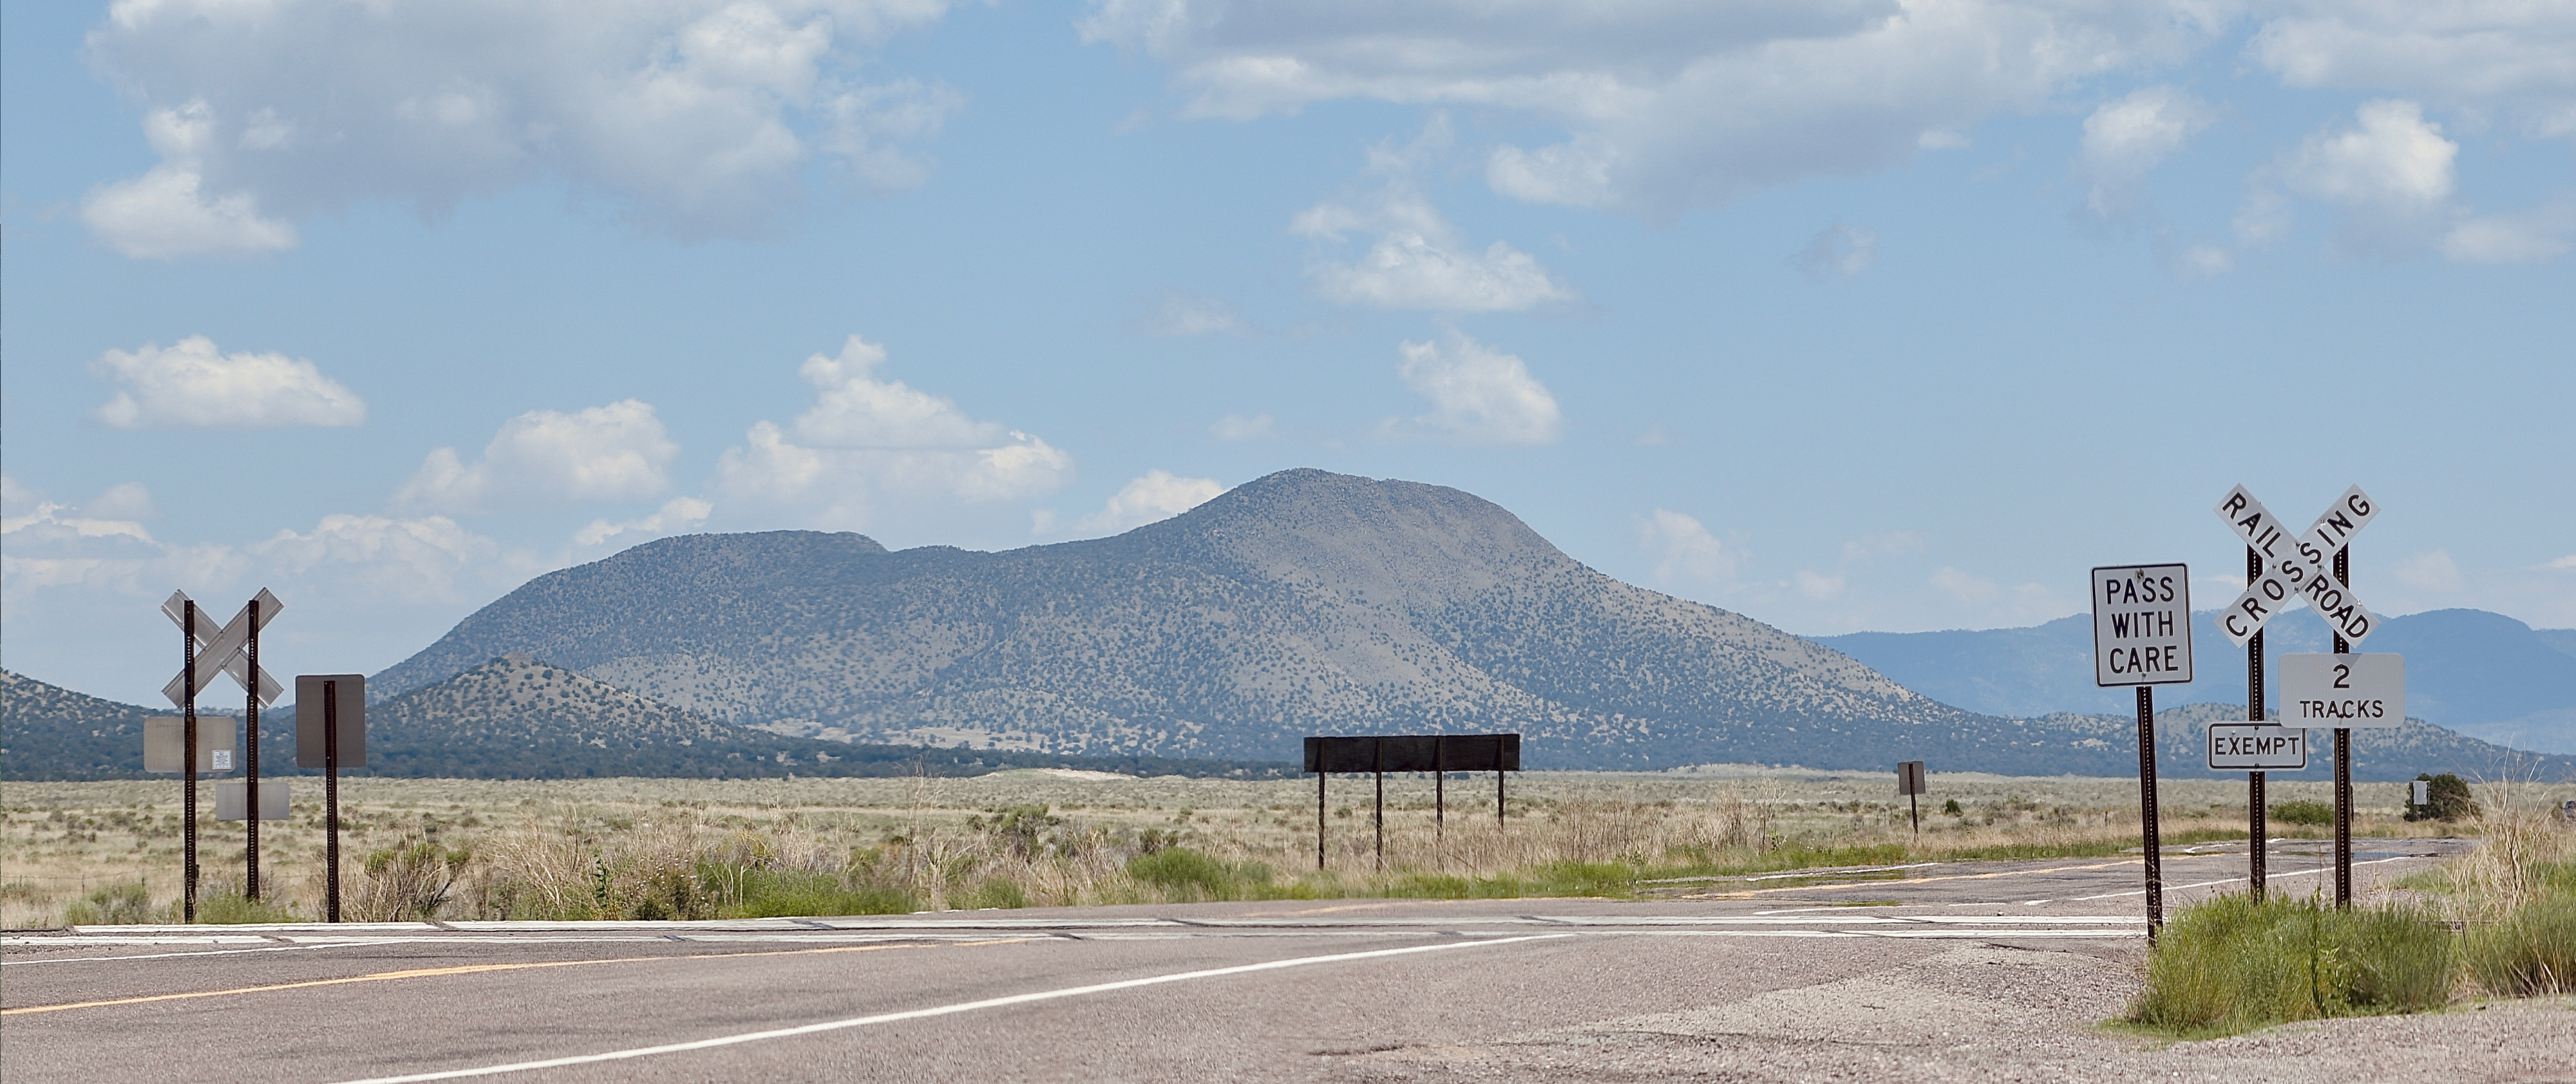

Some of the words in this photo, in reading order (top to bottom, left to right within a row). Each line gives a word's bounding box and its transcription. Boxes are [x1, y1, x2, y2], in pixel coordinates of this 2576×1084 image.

[2222, 492, 2281, 558] RAIL
[2305, 574, 2370, 639] ROAD
[2226, 494, 2371, 637] CROSSING
[2106, 576, 2174, 604] PASS
[2112, 611, 2174, 639] WITH
[2109, 646, 2179, 673] CARE
[2333, 665, 2351, 689] 2
[2300, 700, 2384, 718] TRACKS
[2215, 736, 2300, 756] EXEMPT
